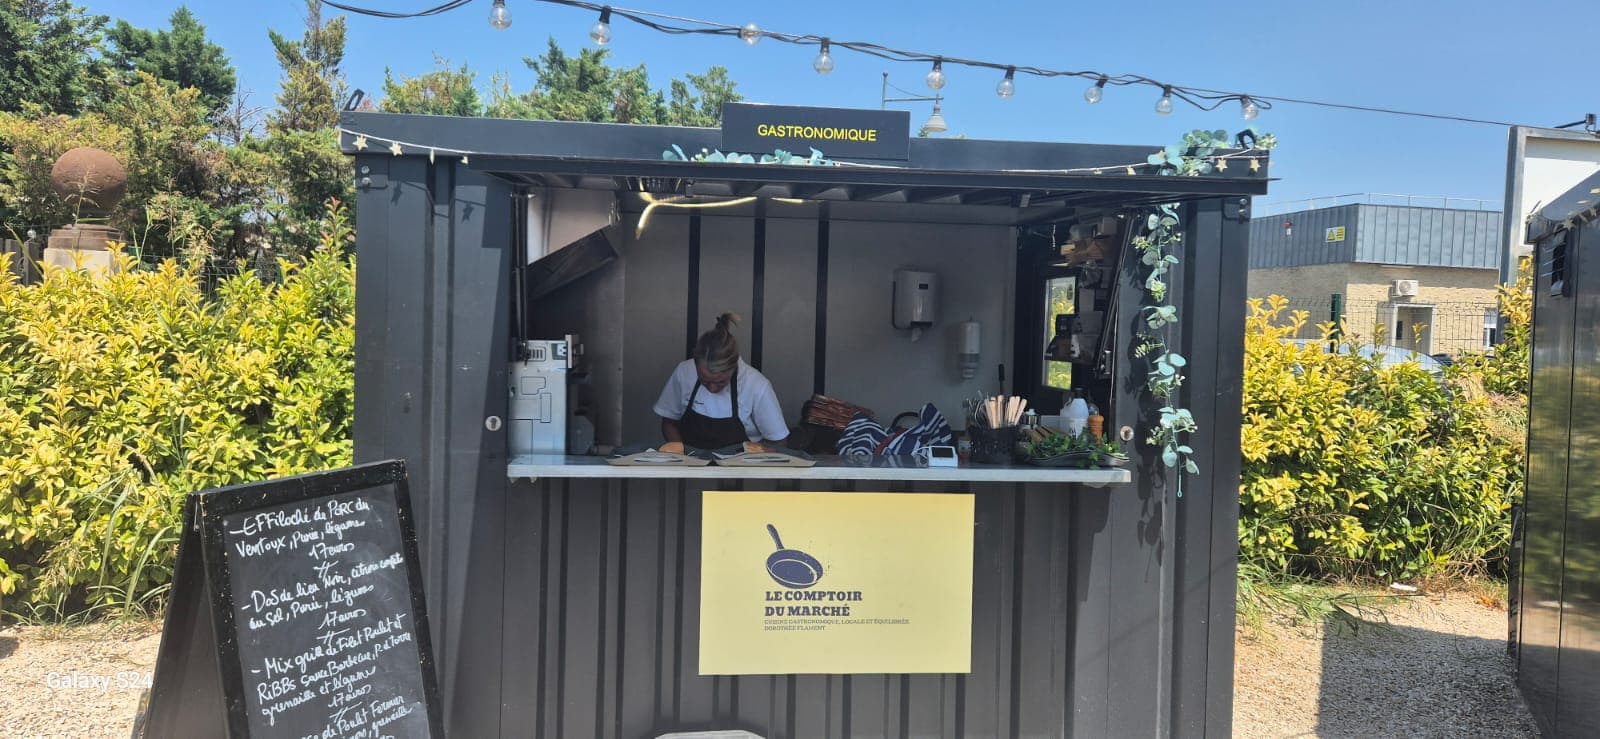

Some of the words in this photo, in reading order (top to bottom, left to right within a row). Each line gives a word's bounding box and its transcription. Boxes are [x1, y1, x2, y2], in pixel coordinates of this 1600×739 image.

[757, 124, 877, 142] GASTRONOMIQUE
[314, 506, 327, 521] de
[355, 497, 370, 511] du
[280, 588, 294, 602] de
[765, 591, 783, 601] LE
[784, 590, 863, 602] COMPTOIR
[765, 606, 785, 617] DU
[787, 603, 850, 617] MARCHÉ
[265, 657, 294, 679] Mix
[319, 680, 332, 694] et
